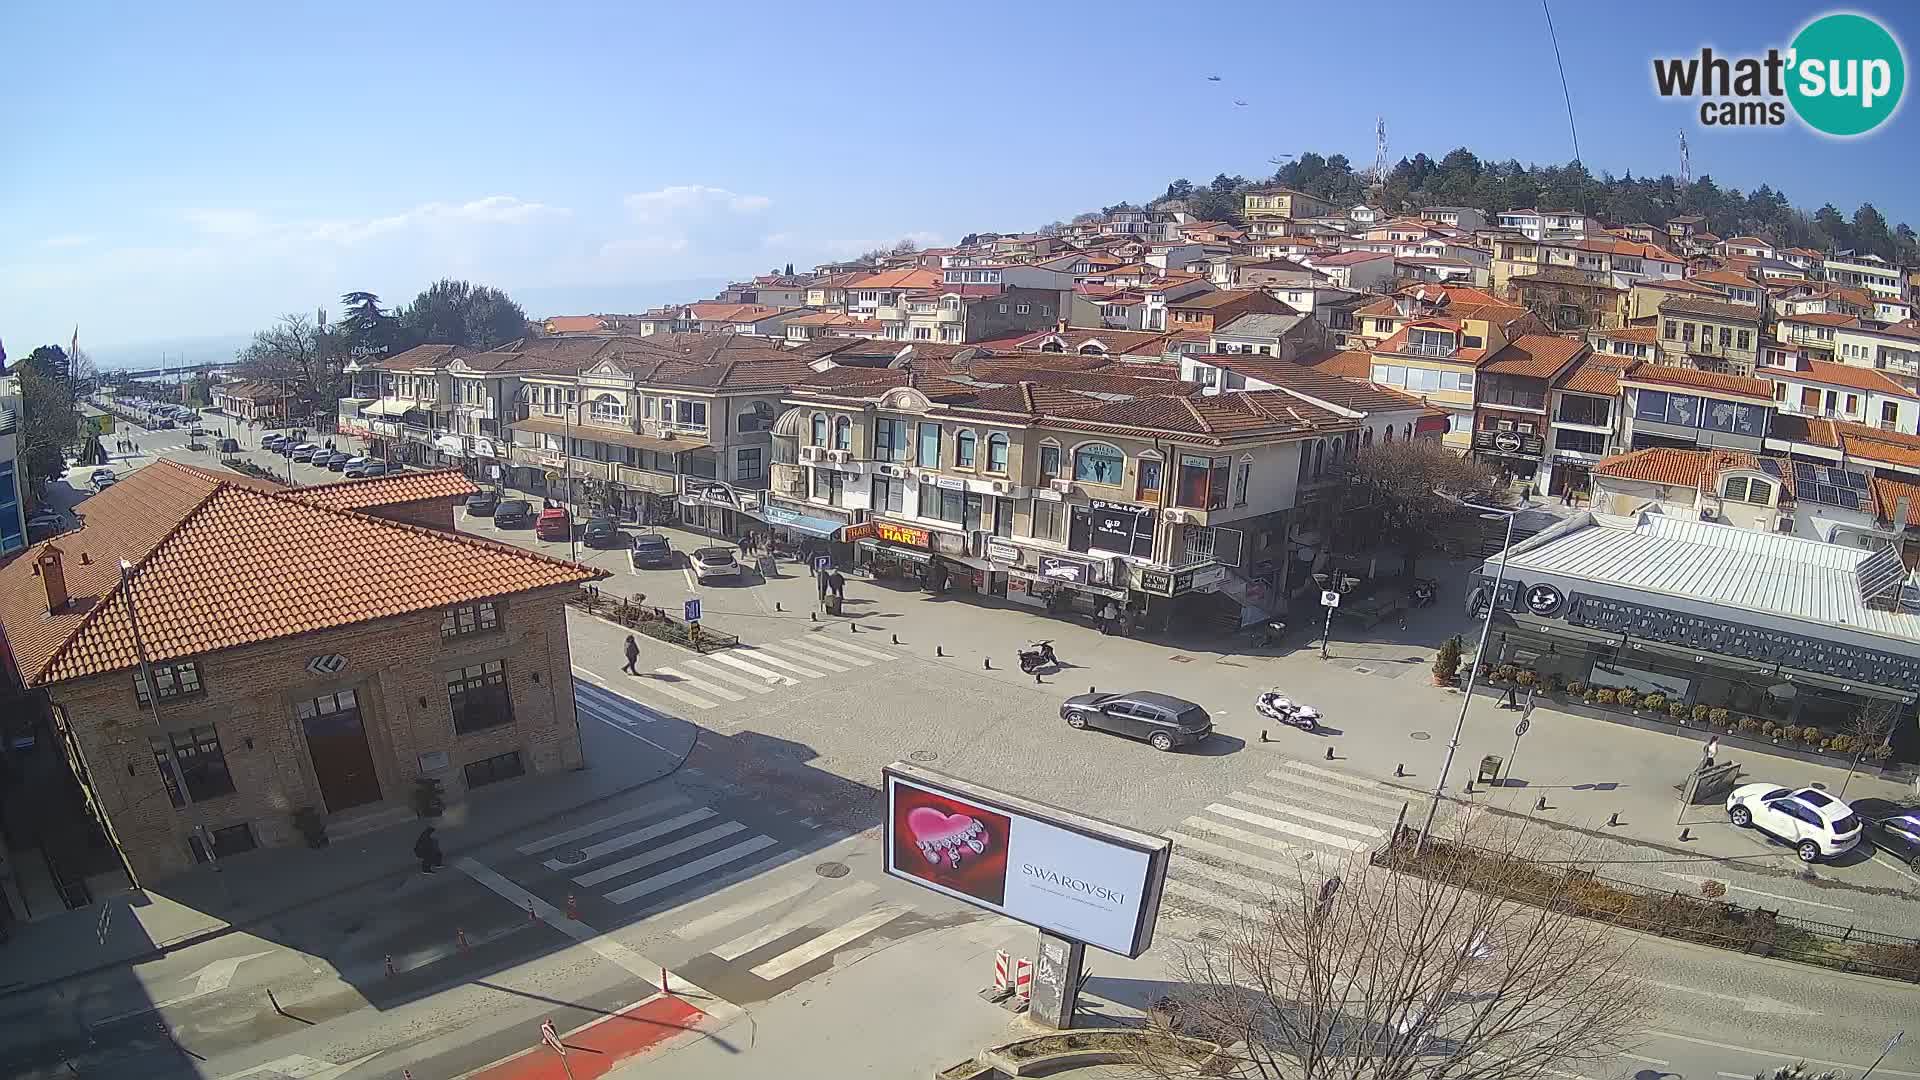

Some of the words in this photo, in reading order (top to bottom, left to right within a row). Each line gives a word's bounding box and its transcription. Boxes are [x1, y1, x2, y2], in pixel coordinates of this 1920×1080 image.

[883, 529, 916, 545] HARI
[819, 558, 826, 568] P
[1022, 863, 1125, 905] SWAROVSKI
